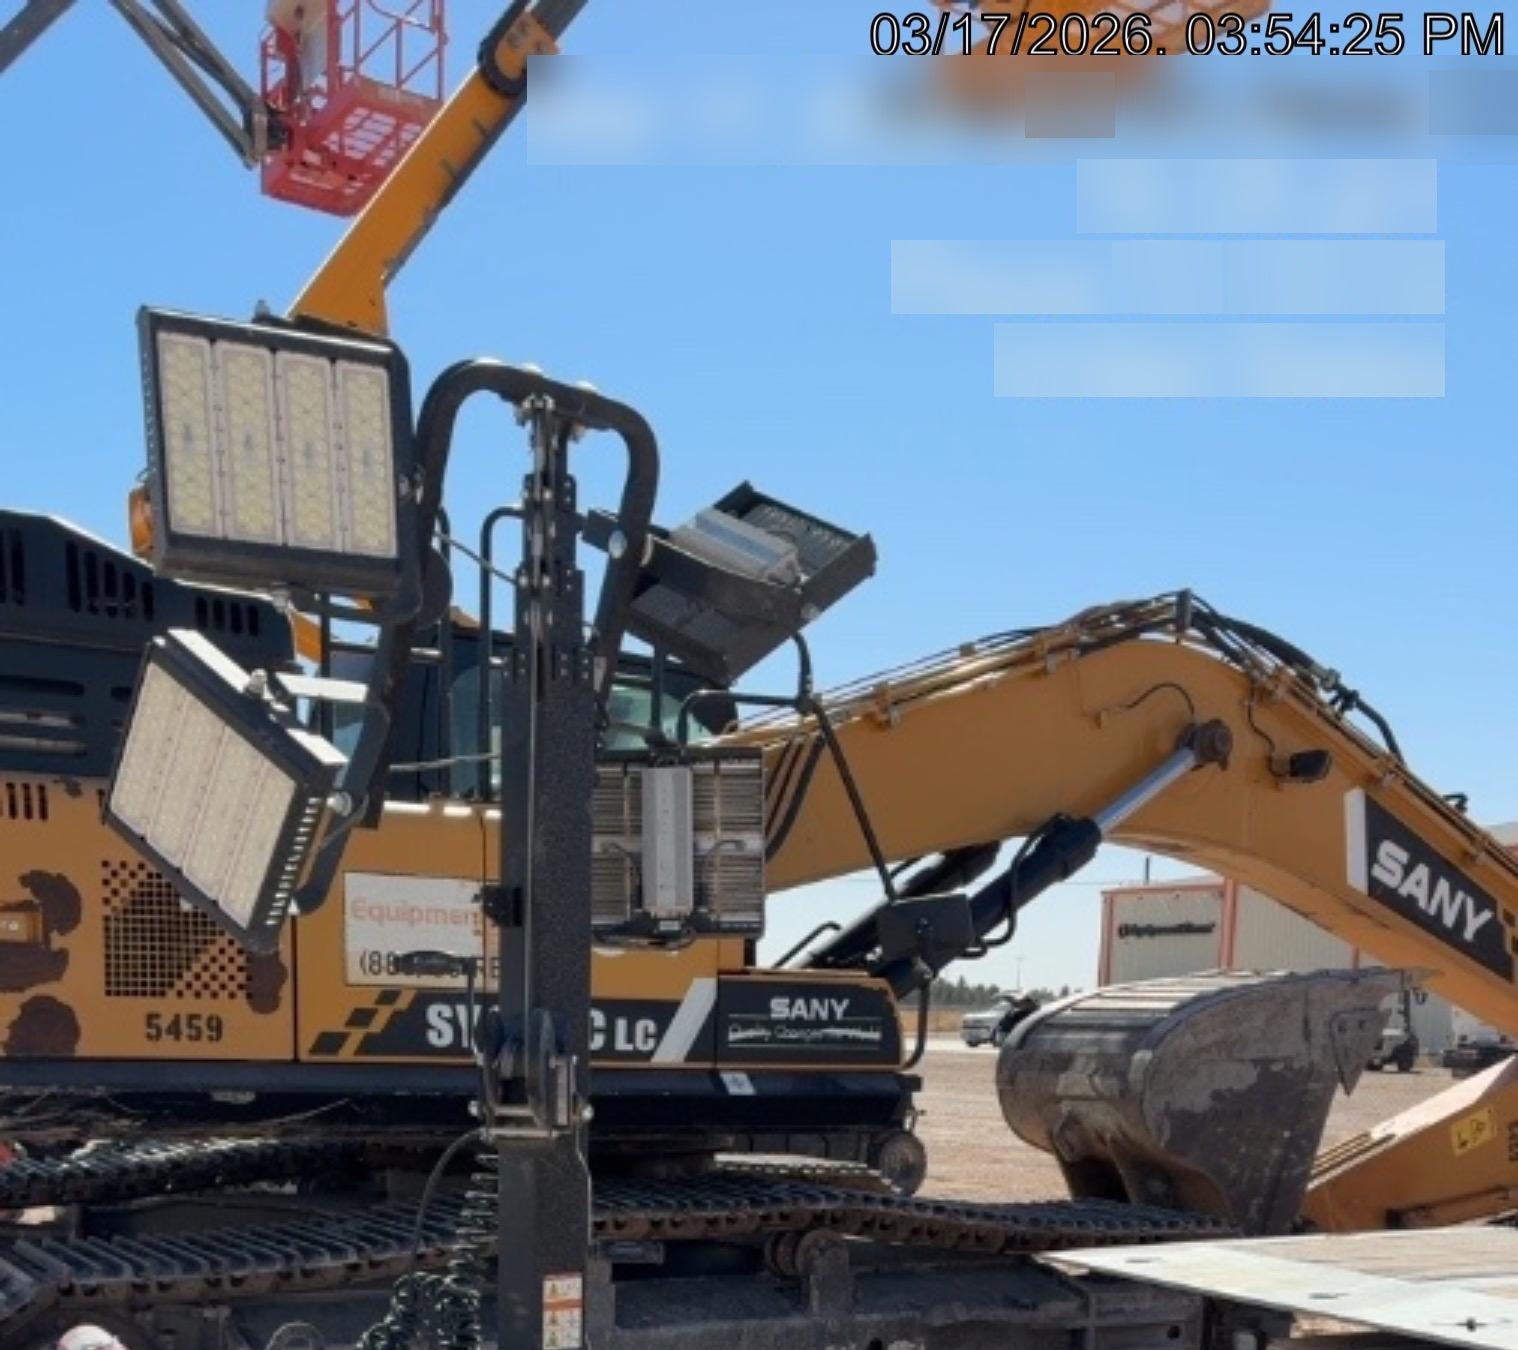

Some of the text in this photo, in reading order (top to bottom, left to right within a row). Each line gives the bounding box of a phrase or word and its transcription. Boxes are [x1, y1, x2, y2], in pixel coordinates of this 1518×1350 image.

[1371, 839, 1494, 942] SANY
[770, 995, 849, 1020] SANY
[145, 1013, 223, 1042] 5459
[614, 1017, 657, 1051] LC
